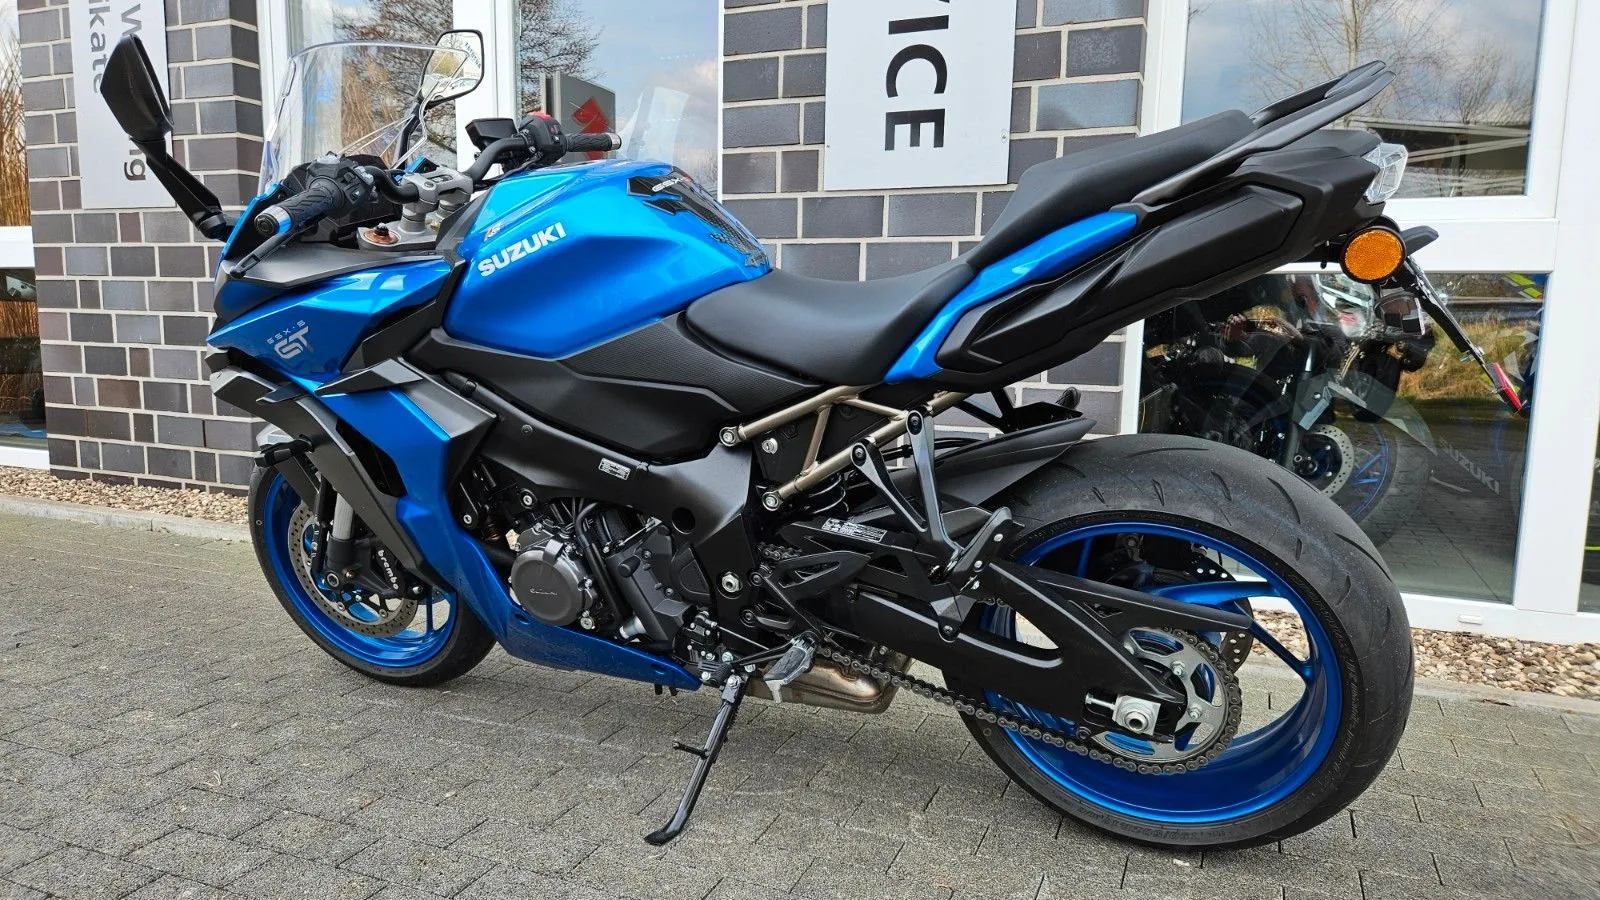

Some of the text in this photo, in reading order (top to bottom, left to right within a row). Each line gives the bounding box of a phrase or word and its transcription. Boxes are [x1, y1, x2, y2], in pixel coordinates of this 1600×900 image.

[885, 0, 950, 151] ICE
[477, 221, 567, 277] SUZUKI
[377, 549, 399, 590] brembo
